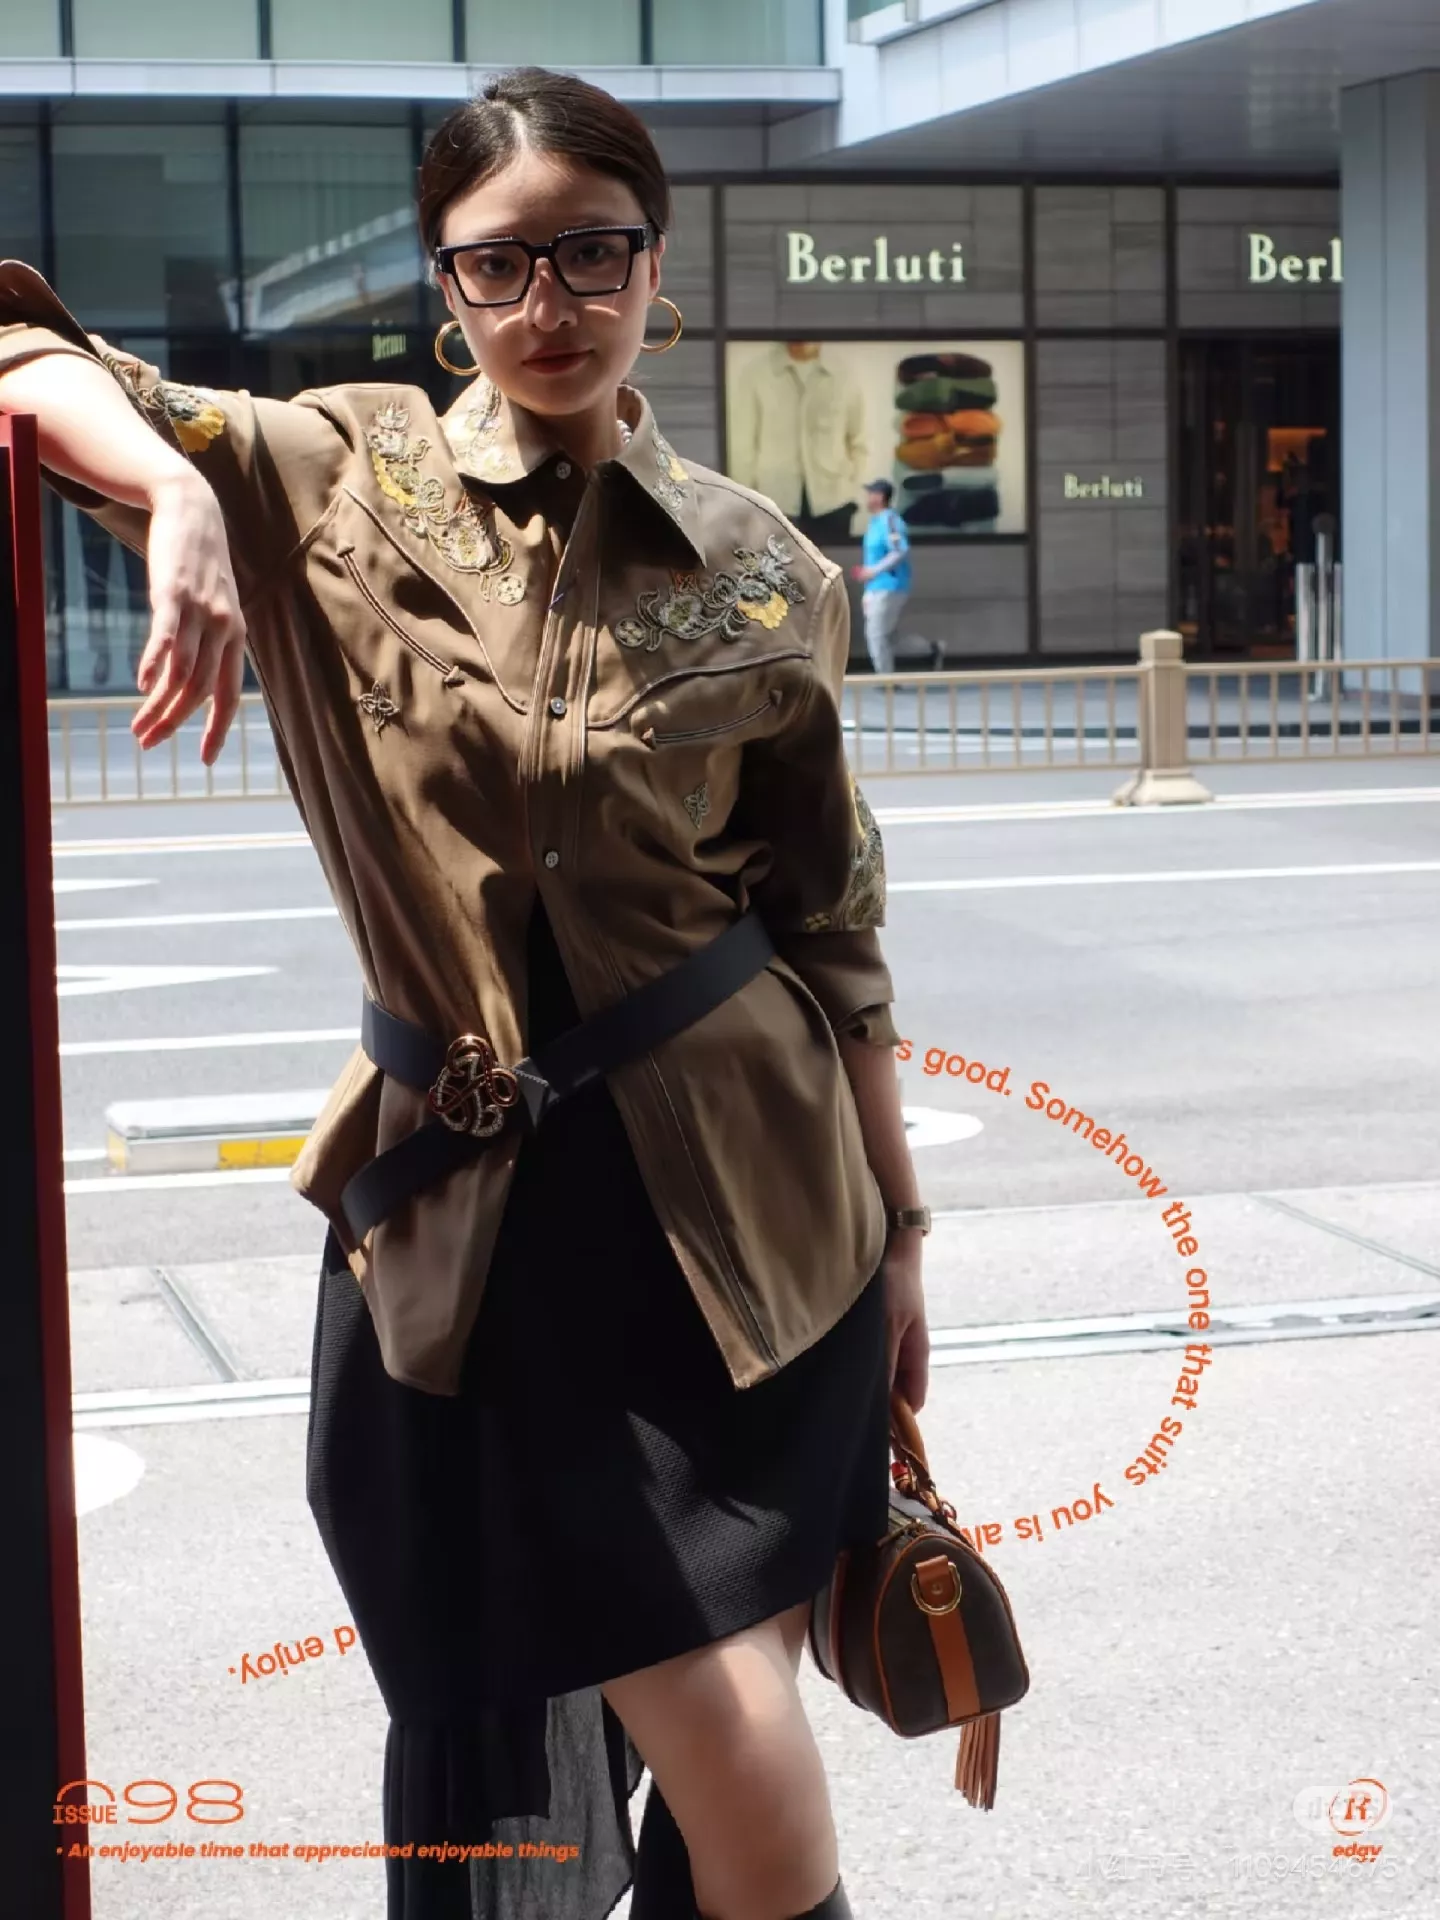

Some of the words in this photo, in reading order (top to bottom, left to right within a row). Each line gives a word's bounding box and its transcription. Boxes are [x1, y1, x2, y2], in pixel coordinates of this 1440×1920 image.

[787, 231, 967, 283] Berluti
[1248, 232, 1344, 284] Berl
[1063, 472, 1143, 499] Berluti
